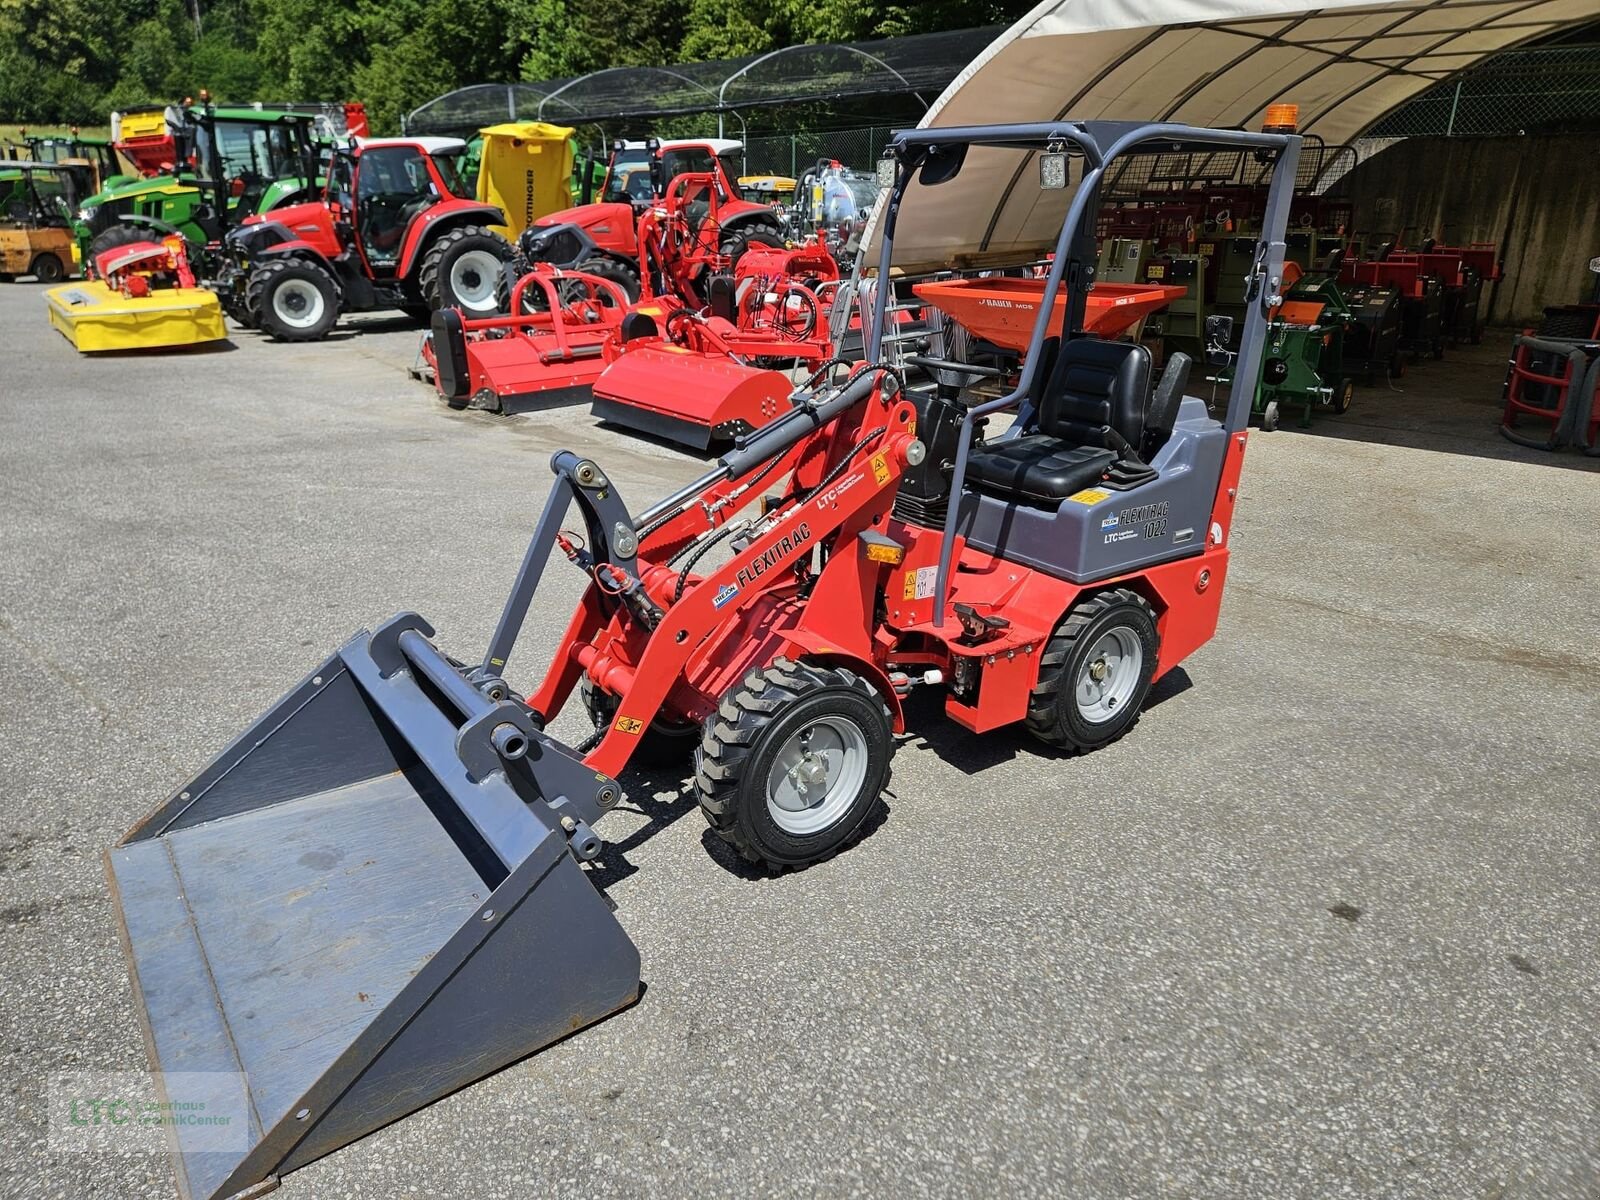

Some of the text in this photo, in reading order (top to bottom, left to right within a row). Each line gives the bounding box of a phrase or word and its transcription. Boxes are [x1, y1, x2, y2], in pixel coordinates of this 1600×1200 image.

[816, 489, 838, 510] LTC
[1119, 501, 1169, 525] FLEXITRAC
[1104, 533, 1119, 544] LTC
[1143, 518, 1169, 540] 1022
[736, 522, 811, 588] FLEXITRAC
[714, 585, 736, 605] TREJON
